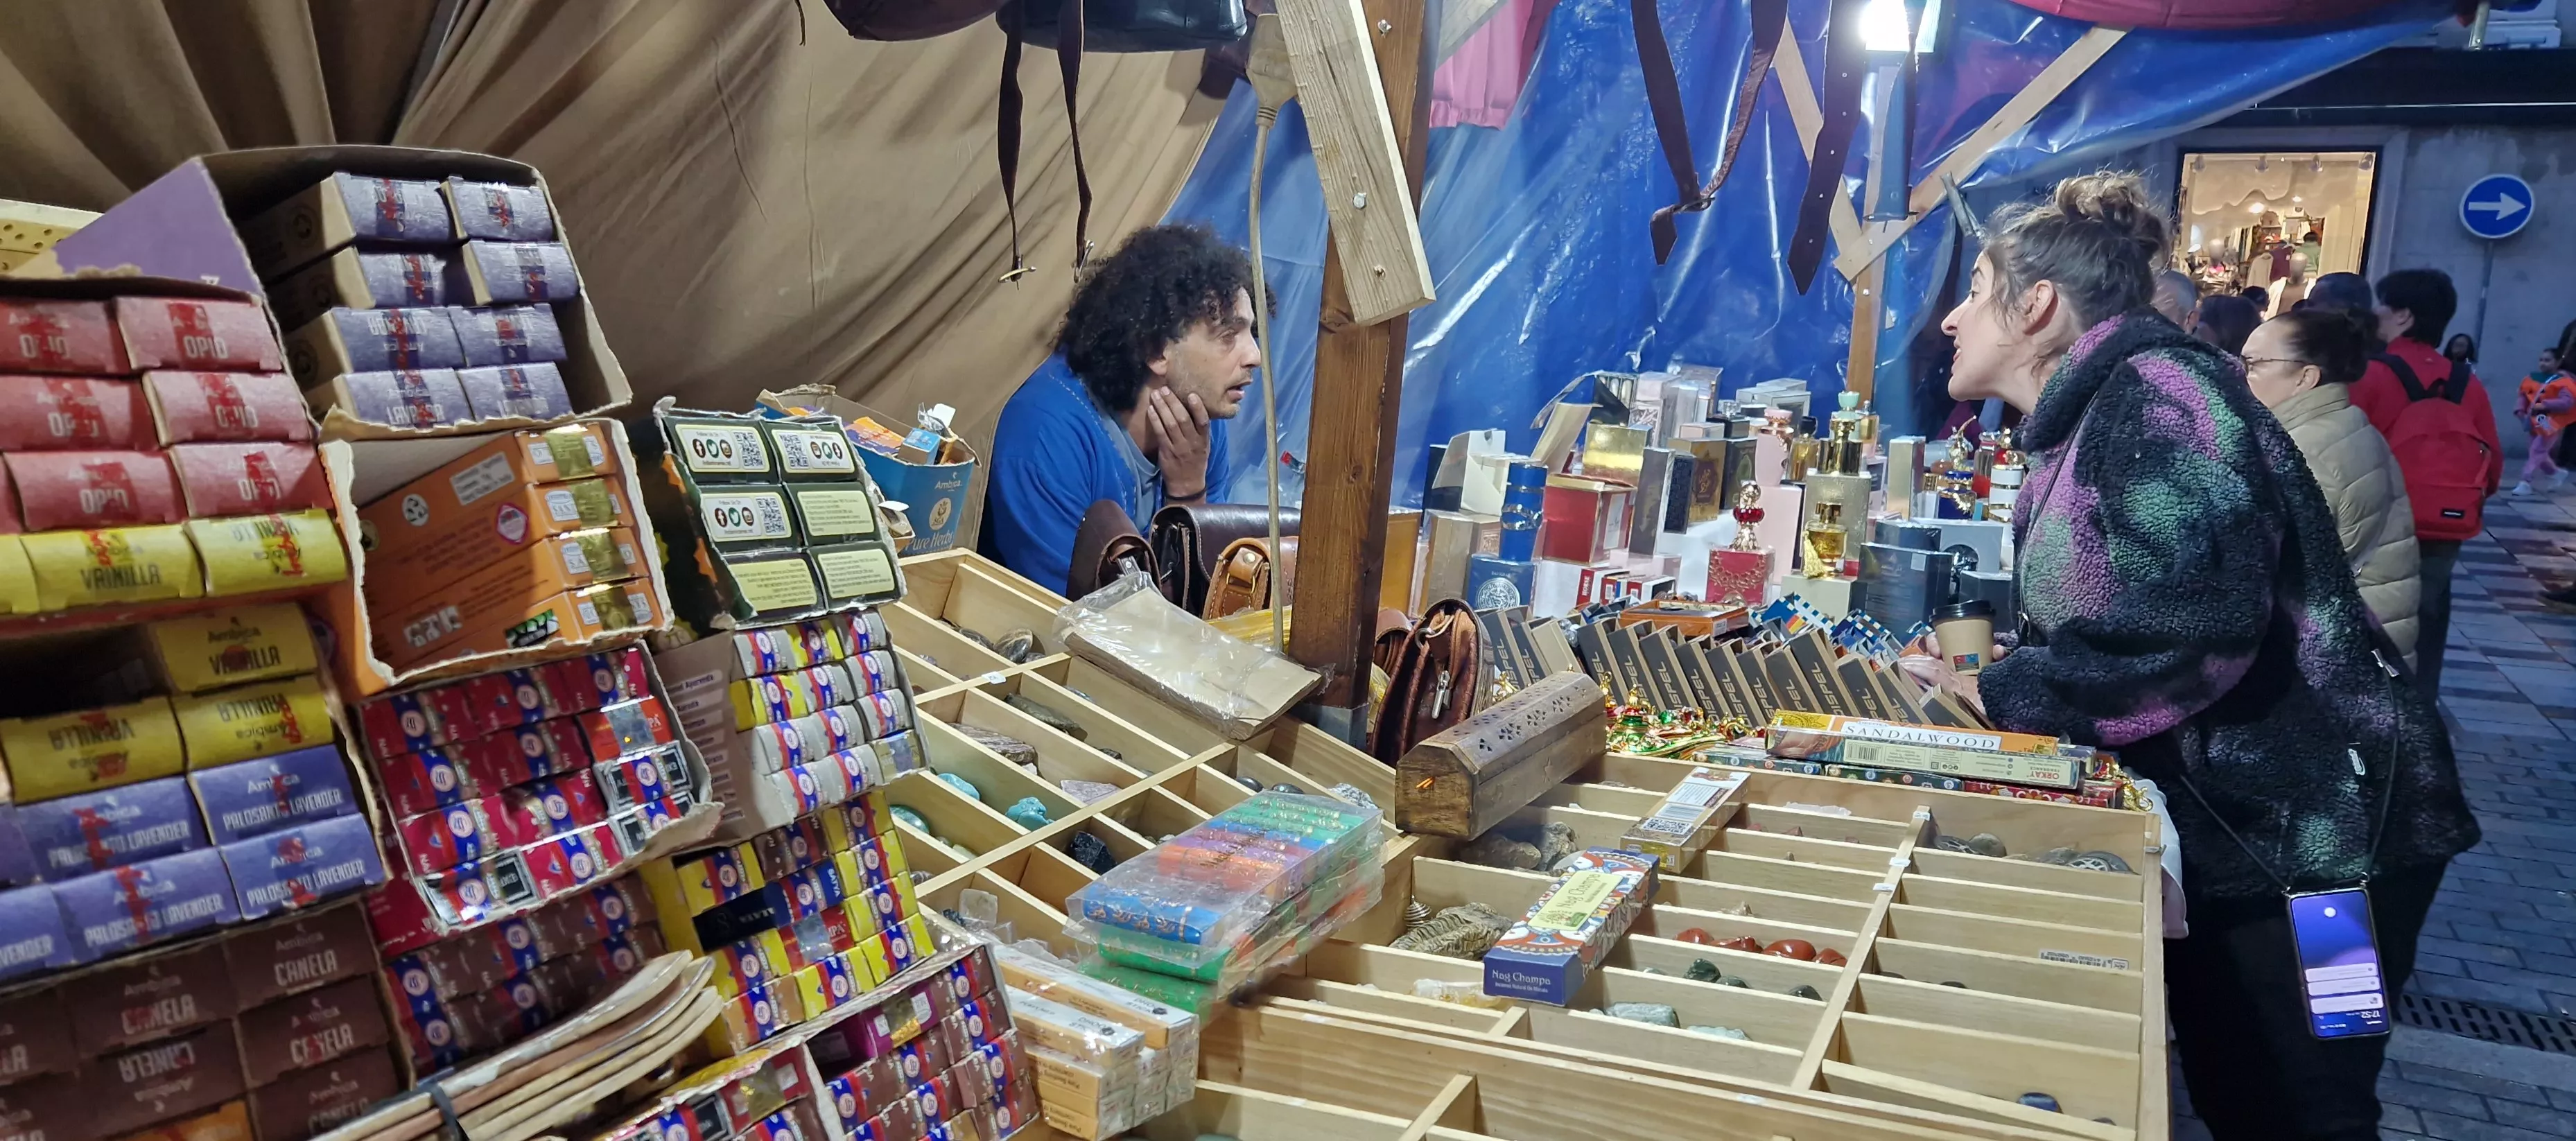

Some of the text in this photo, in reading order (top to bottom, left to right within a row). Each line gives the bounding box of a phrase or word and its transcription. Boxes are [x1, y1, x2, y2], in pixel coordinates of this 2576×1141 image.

[182, 334, 229, 359] OPIO
[934, 479, 962, 489] Ambica
[930, 529, 954, 549] Herbs
[80, 564, 162, 590] VAINILLA
[1581, 575, 1590, 597] HORSE
[1522, 648, 1541, 683] SPEL
[1592, 652, 1607, 684] PEL
[1624, 655, 1649, 703] ISPEL
[1657, 661, 1683, 711] ISPEL
[1691, 669, 1719, 723] DISPEL
[1754, 677, 1776, 720] SPEL
[1786, 679, 1808, 711] PEL
[216, 693, 288, 722] AINILLA
[1845, 725, 1995, 749] SANDALWOOD
[247, 773, 301, 794] Amca
[2030, 770, 2060, 780] ORKAY
[290, 788, 343, 815] LAVENDER
[128, 819, 190, 851] LAVENDER
[246, 860, 365, 907] PALOSATO LAVENDER
[827, 868, 841, 898] SATYA
[1568, 873, 1601, 896] Champa
[1556, 896, 1583, 909] Nag
[82, 893, 225, 948] PALOSATO LAVENDER
[274, 950, 338, 985] CANELA
[1492, 969, 1551, 986] Nag Champa
[121, 993, 198, 1036] CNELA
